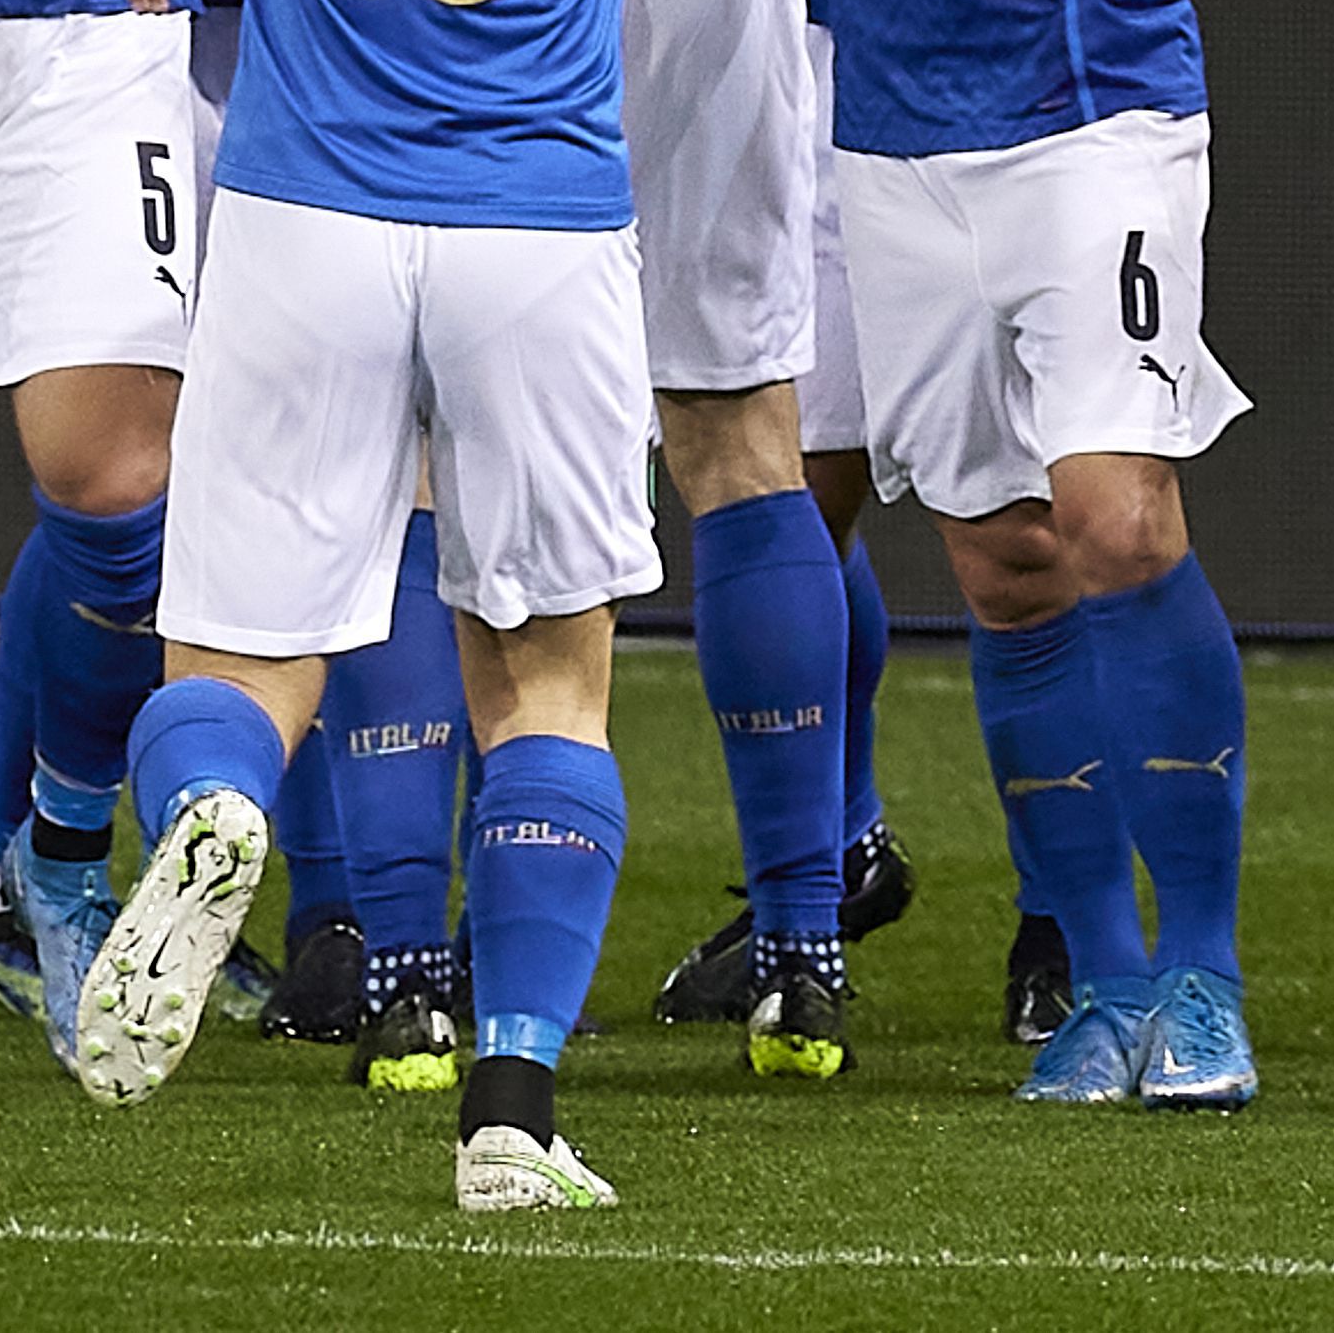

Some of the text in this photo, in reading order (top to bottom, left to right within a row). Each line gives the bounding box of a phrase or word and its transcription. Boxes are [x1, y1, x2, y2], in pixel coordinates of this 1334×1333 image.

[135, 140, 176, 256] 5
[1120, 229, 1160, 341] 6
[349, 722, 452, 753] ITALIA
